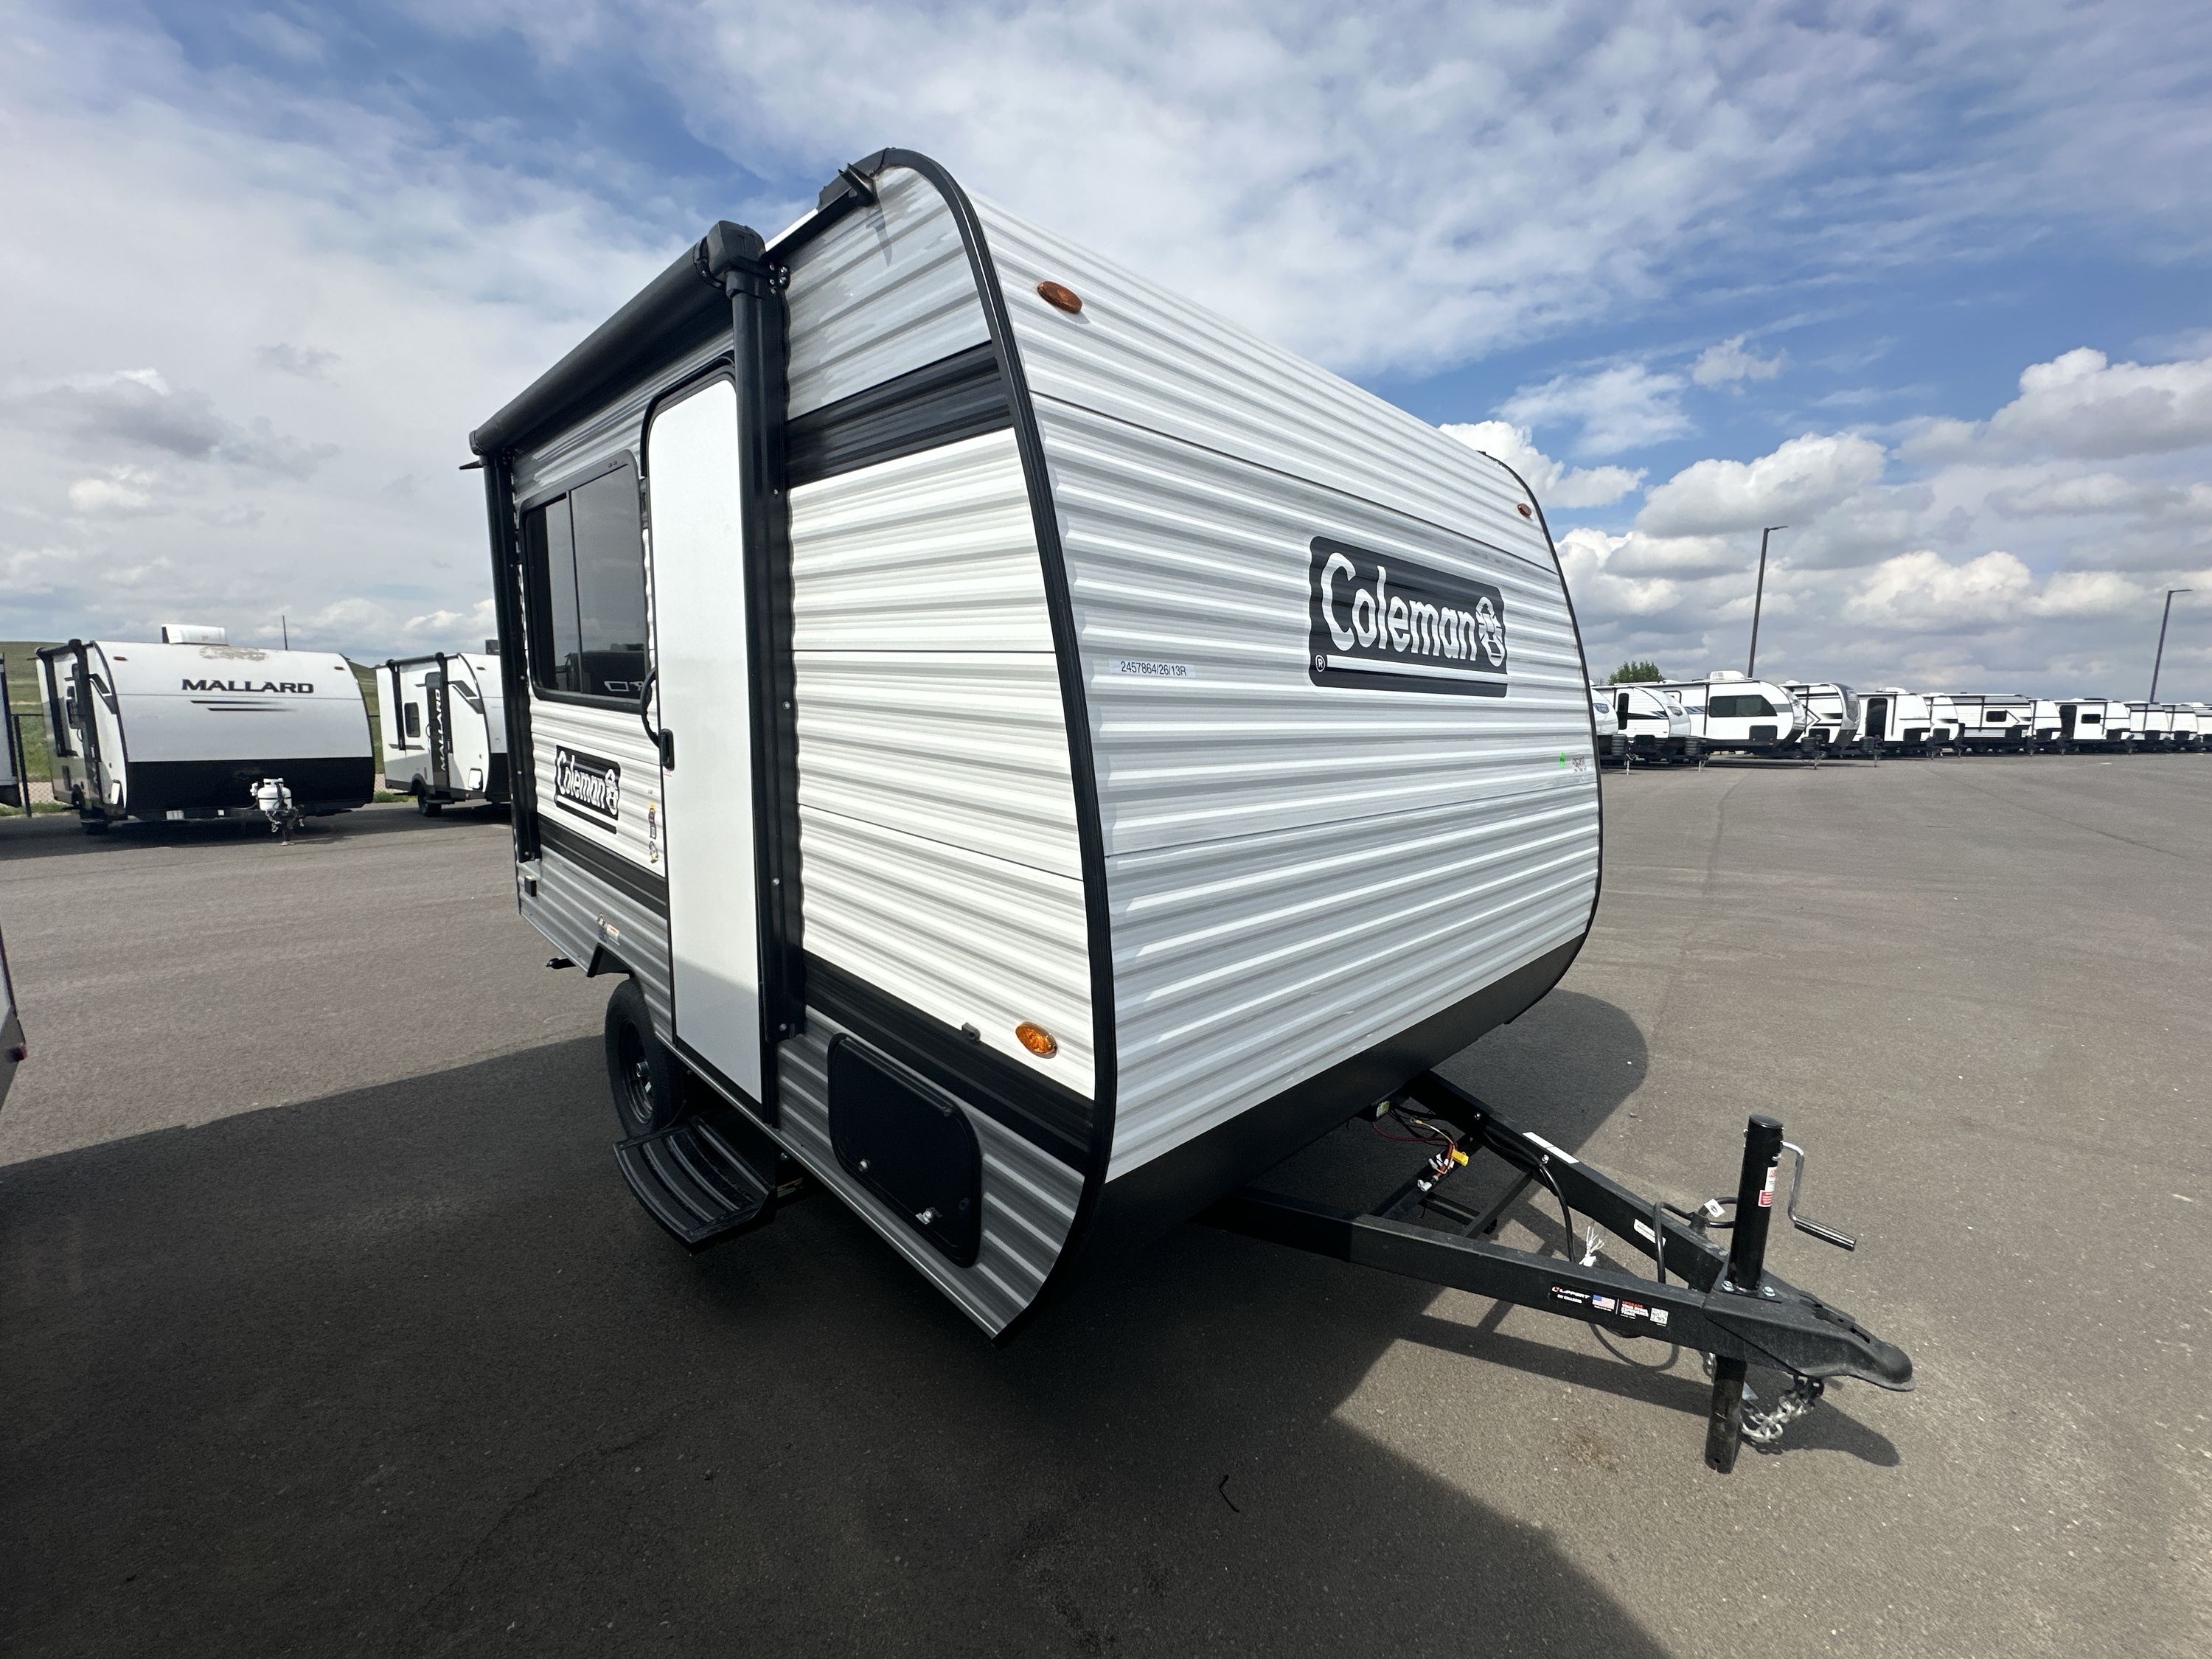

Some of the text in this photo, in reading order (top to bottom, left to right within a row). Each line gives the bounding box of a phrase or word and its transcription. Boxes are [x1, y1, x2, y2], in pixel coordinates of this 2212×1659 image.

[1321, 552, 1477, 661] Coleman
[181, 678, 314, 694] MALLARD
[1120, 661, 1187, 676] 2457864/26/13R
[557, 750, 605, 810] Coleman
